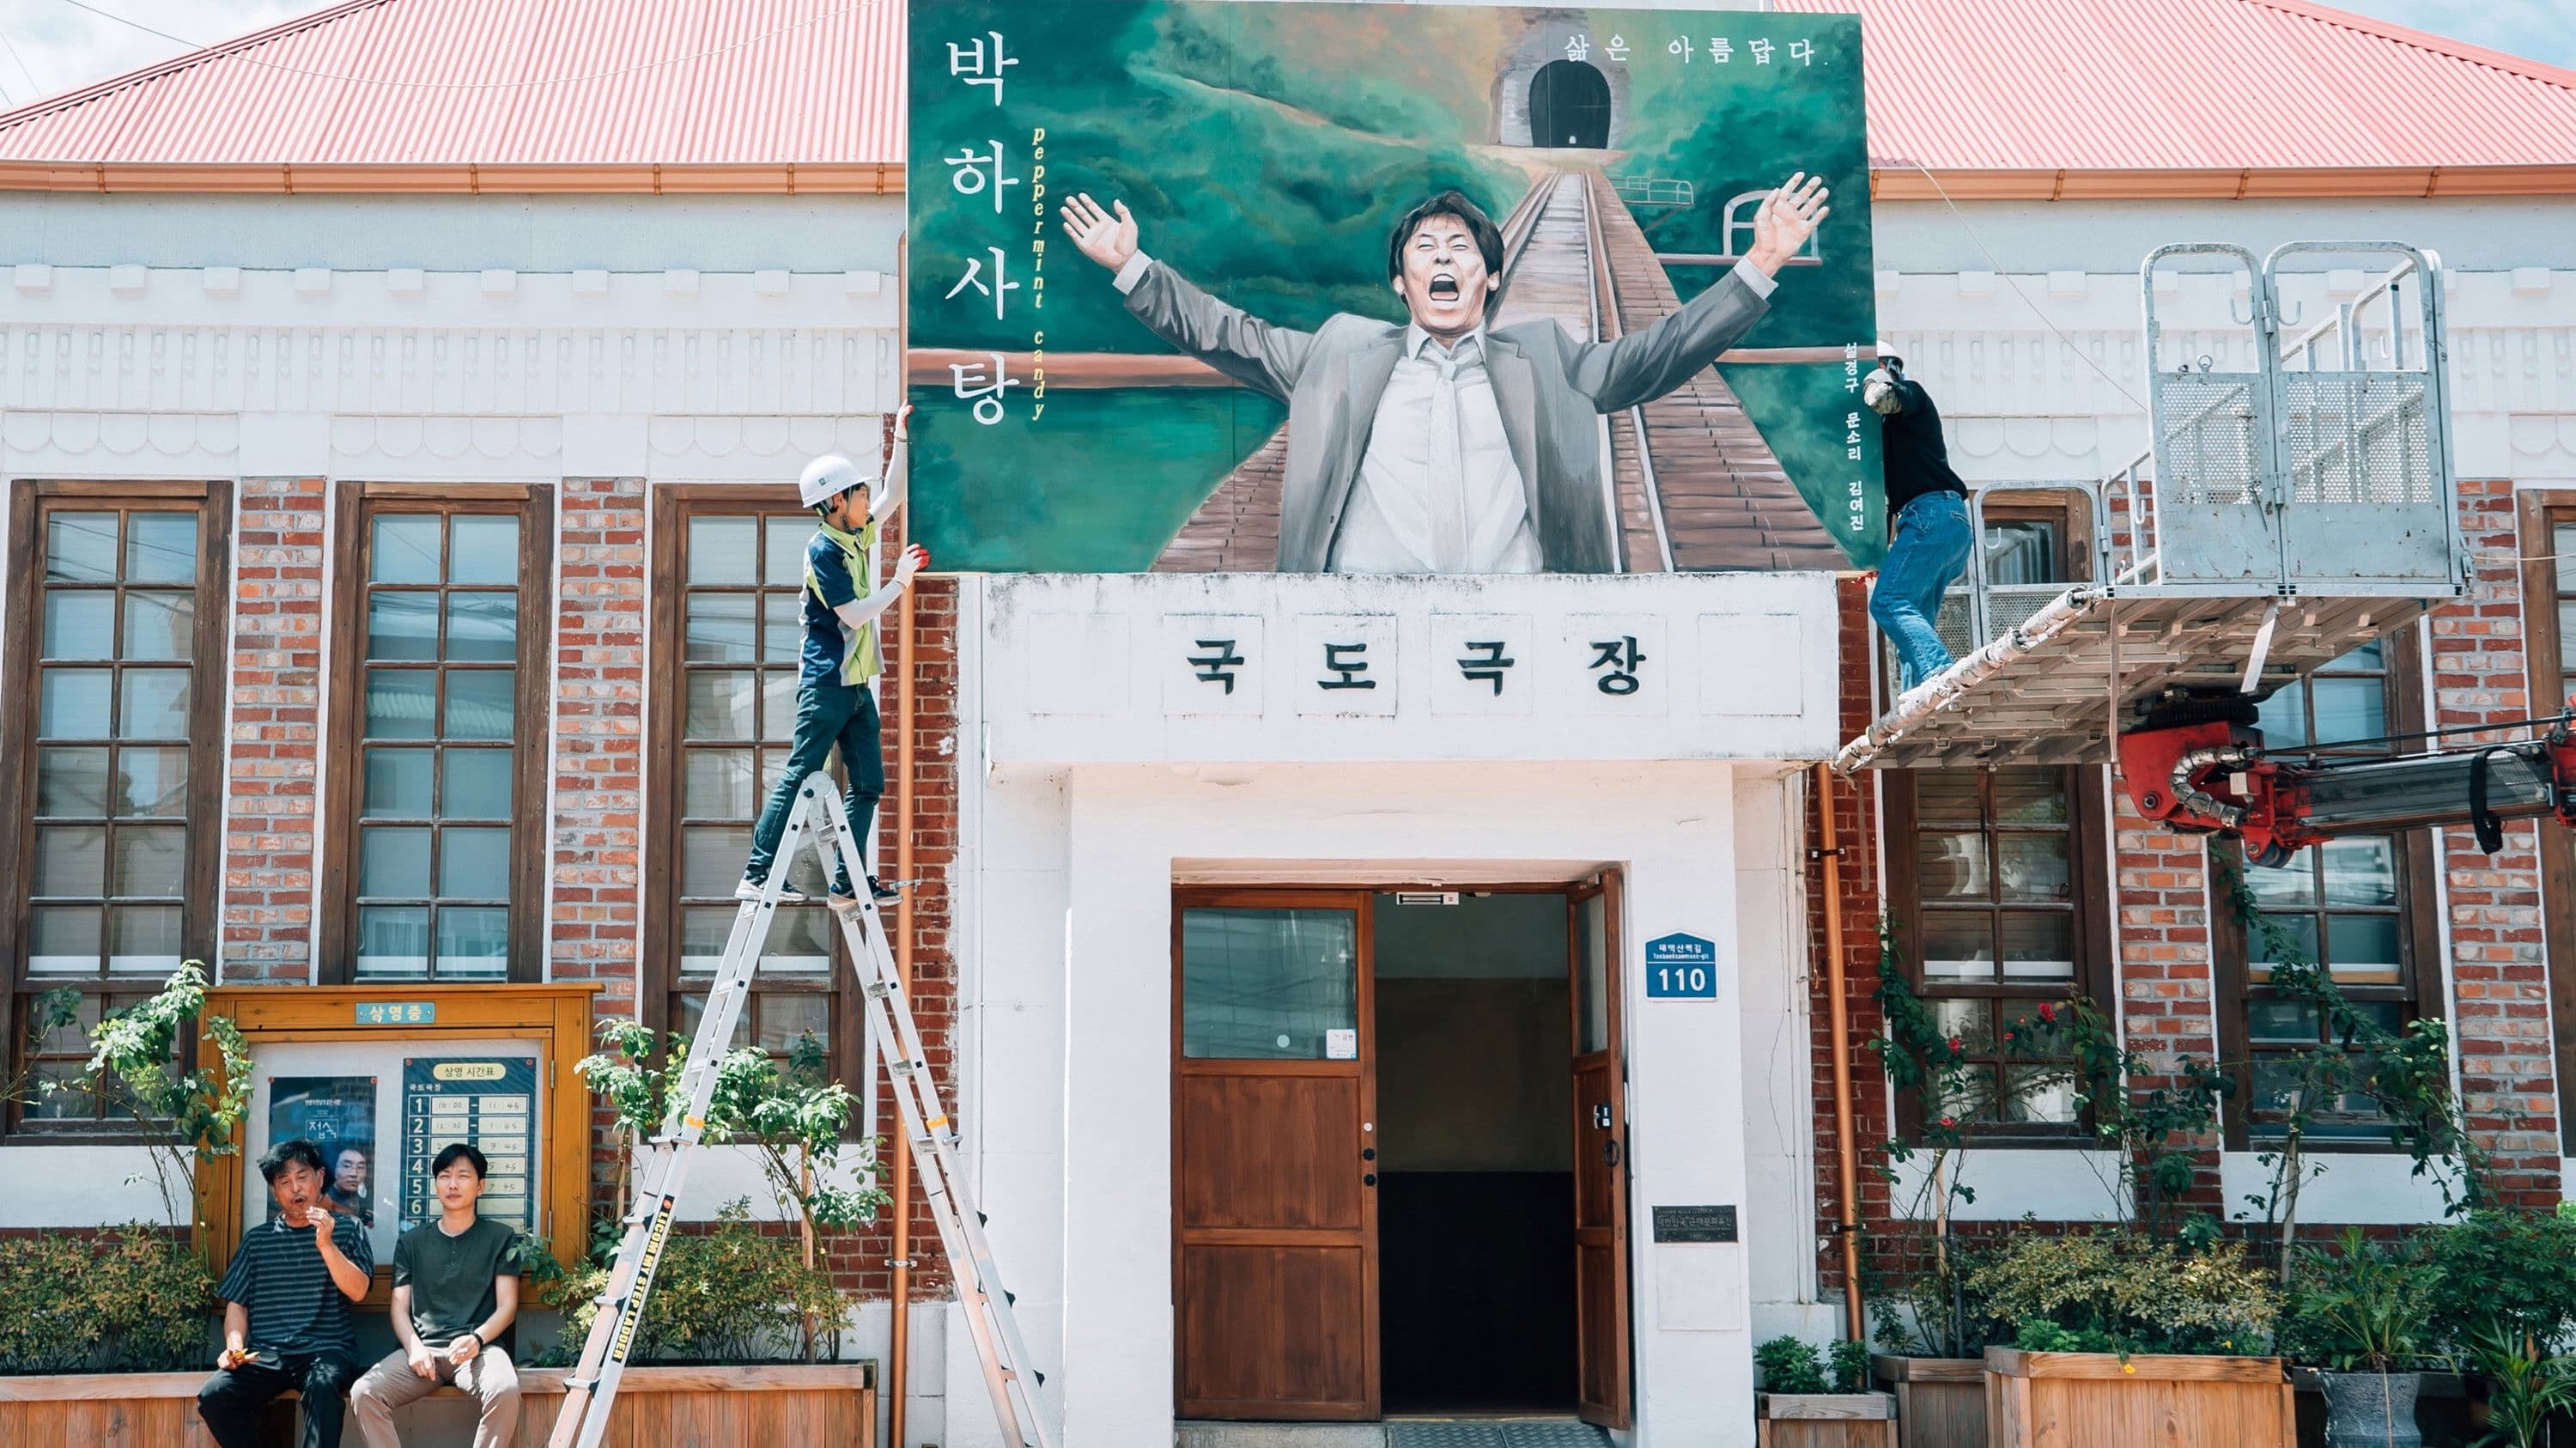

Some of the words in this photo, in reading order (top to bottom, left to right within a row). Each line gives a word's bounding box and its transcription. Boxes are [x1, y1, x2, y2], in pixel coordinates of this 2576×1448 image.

[1564, 33, 1631, 62] 삶은
[1668, 35, 1828, 65] 아름답다.
[945, 30, 1020, 426] 박하사탕
[1031, 126, 1047, 309] peppermint
[1031, 330, 1046, 421] candy
[1844, 342, 1859, 393] 설경구
[1845, 411, 1862, 461] 문소리
[1849, 480, 1864, 532] 김여진
[1186, 636, 1647, 697] 국도극장
[1658, 968, 1705, 991] 110
[370, 1004, 422, 1022] 상영중
[444, 1067, 463, 1078] 상영
[466, 1067, 495, 1078] 시간표
[415, 1098, 422, 1113] 1
[413, 1118, 423, 1134] 2
[413, 1138, 423, 1153] 3
[412, 1158, 423, 1174] 4
[412, 1178, 422, 1195] 5
[411, 1199, 422, 1214] 6
[630, 1276, 647, 1309] STEP
[613, 1309, 637, 1360] LADDER
